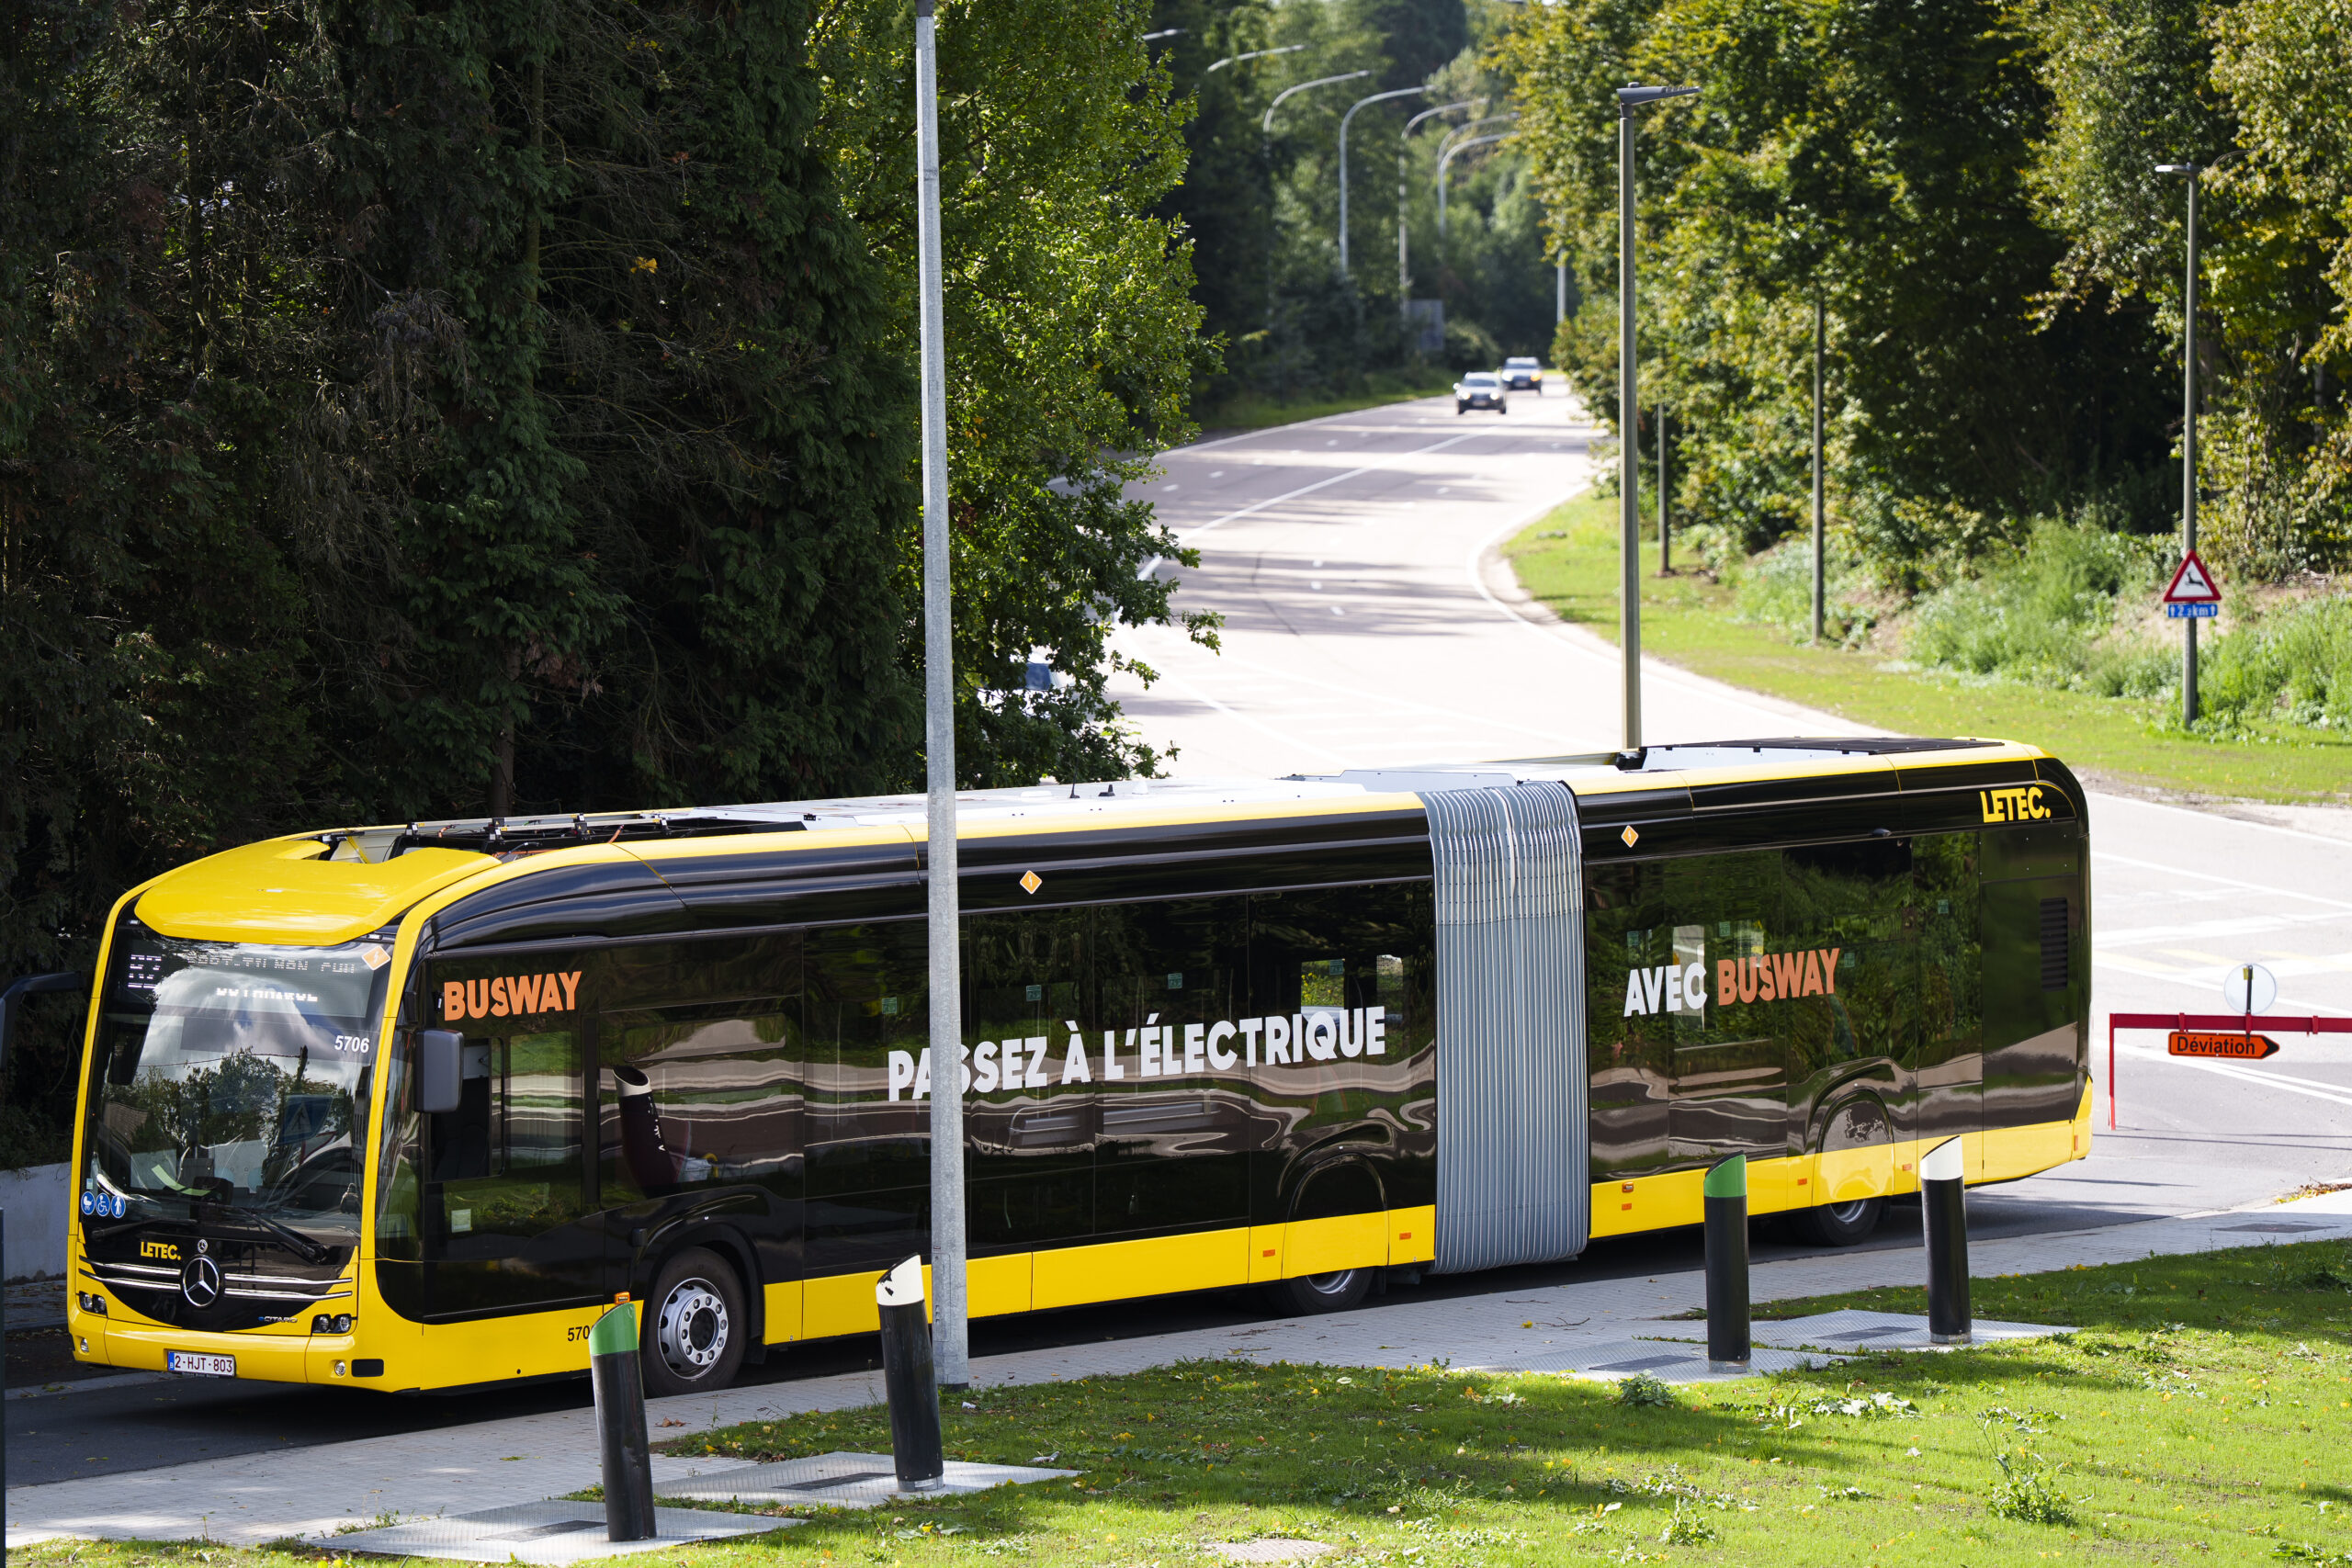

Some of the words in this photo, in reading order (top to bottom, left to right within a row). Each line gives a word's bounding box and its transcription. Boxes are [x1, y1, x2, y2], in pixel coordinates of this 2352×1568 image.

[1979, 786, 2052, 823] LETEC.
[1623, 962, 1708, 1018] AVEC
[1716, 947, 1840, 1007] BUSWAY
[443, 970, 582, 1021] BUSWAY
[334, 1034, 370, 1054] 5706
[1060, 1020, 1091, 1085] À
[1103, 1005, 1385, 1081] L'ÉLECTRIQUE
[2177, 1035, 2256, 1055] Déviation
[140, 1240, 182, 1261] LETEC.
[567, 1325, 591, 1342] 570
[175, 1355, 233, 1373] 2-HJT-803
